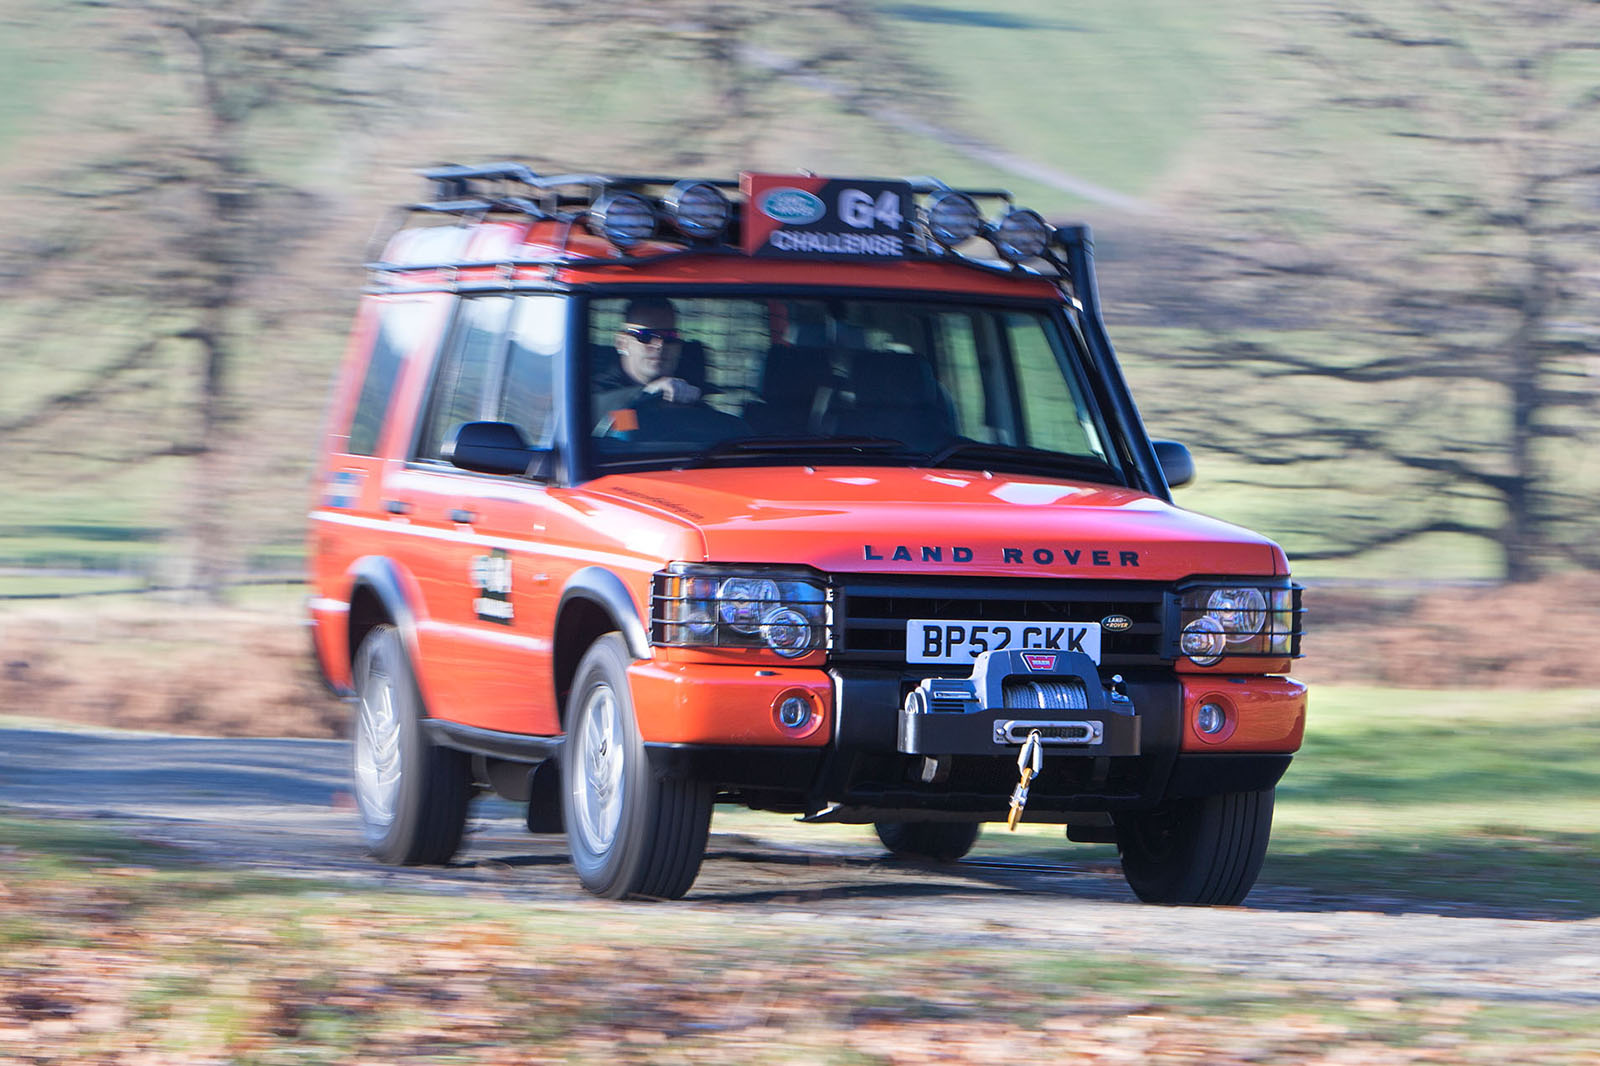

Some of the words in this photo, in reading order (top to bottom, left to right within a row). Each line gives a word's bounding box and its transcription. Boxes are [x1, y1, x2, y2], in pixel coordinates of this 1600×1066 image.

[838, 188, 904, 230] G4
[769, 229, 904, 256] CHALLENGE
[864, 545, 974, 563] LAND
[1002, 547, 1140, 567] ROVER
[922, 625, 1012, 658] BP52
[1022, 627, 1088, 653] GKK
